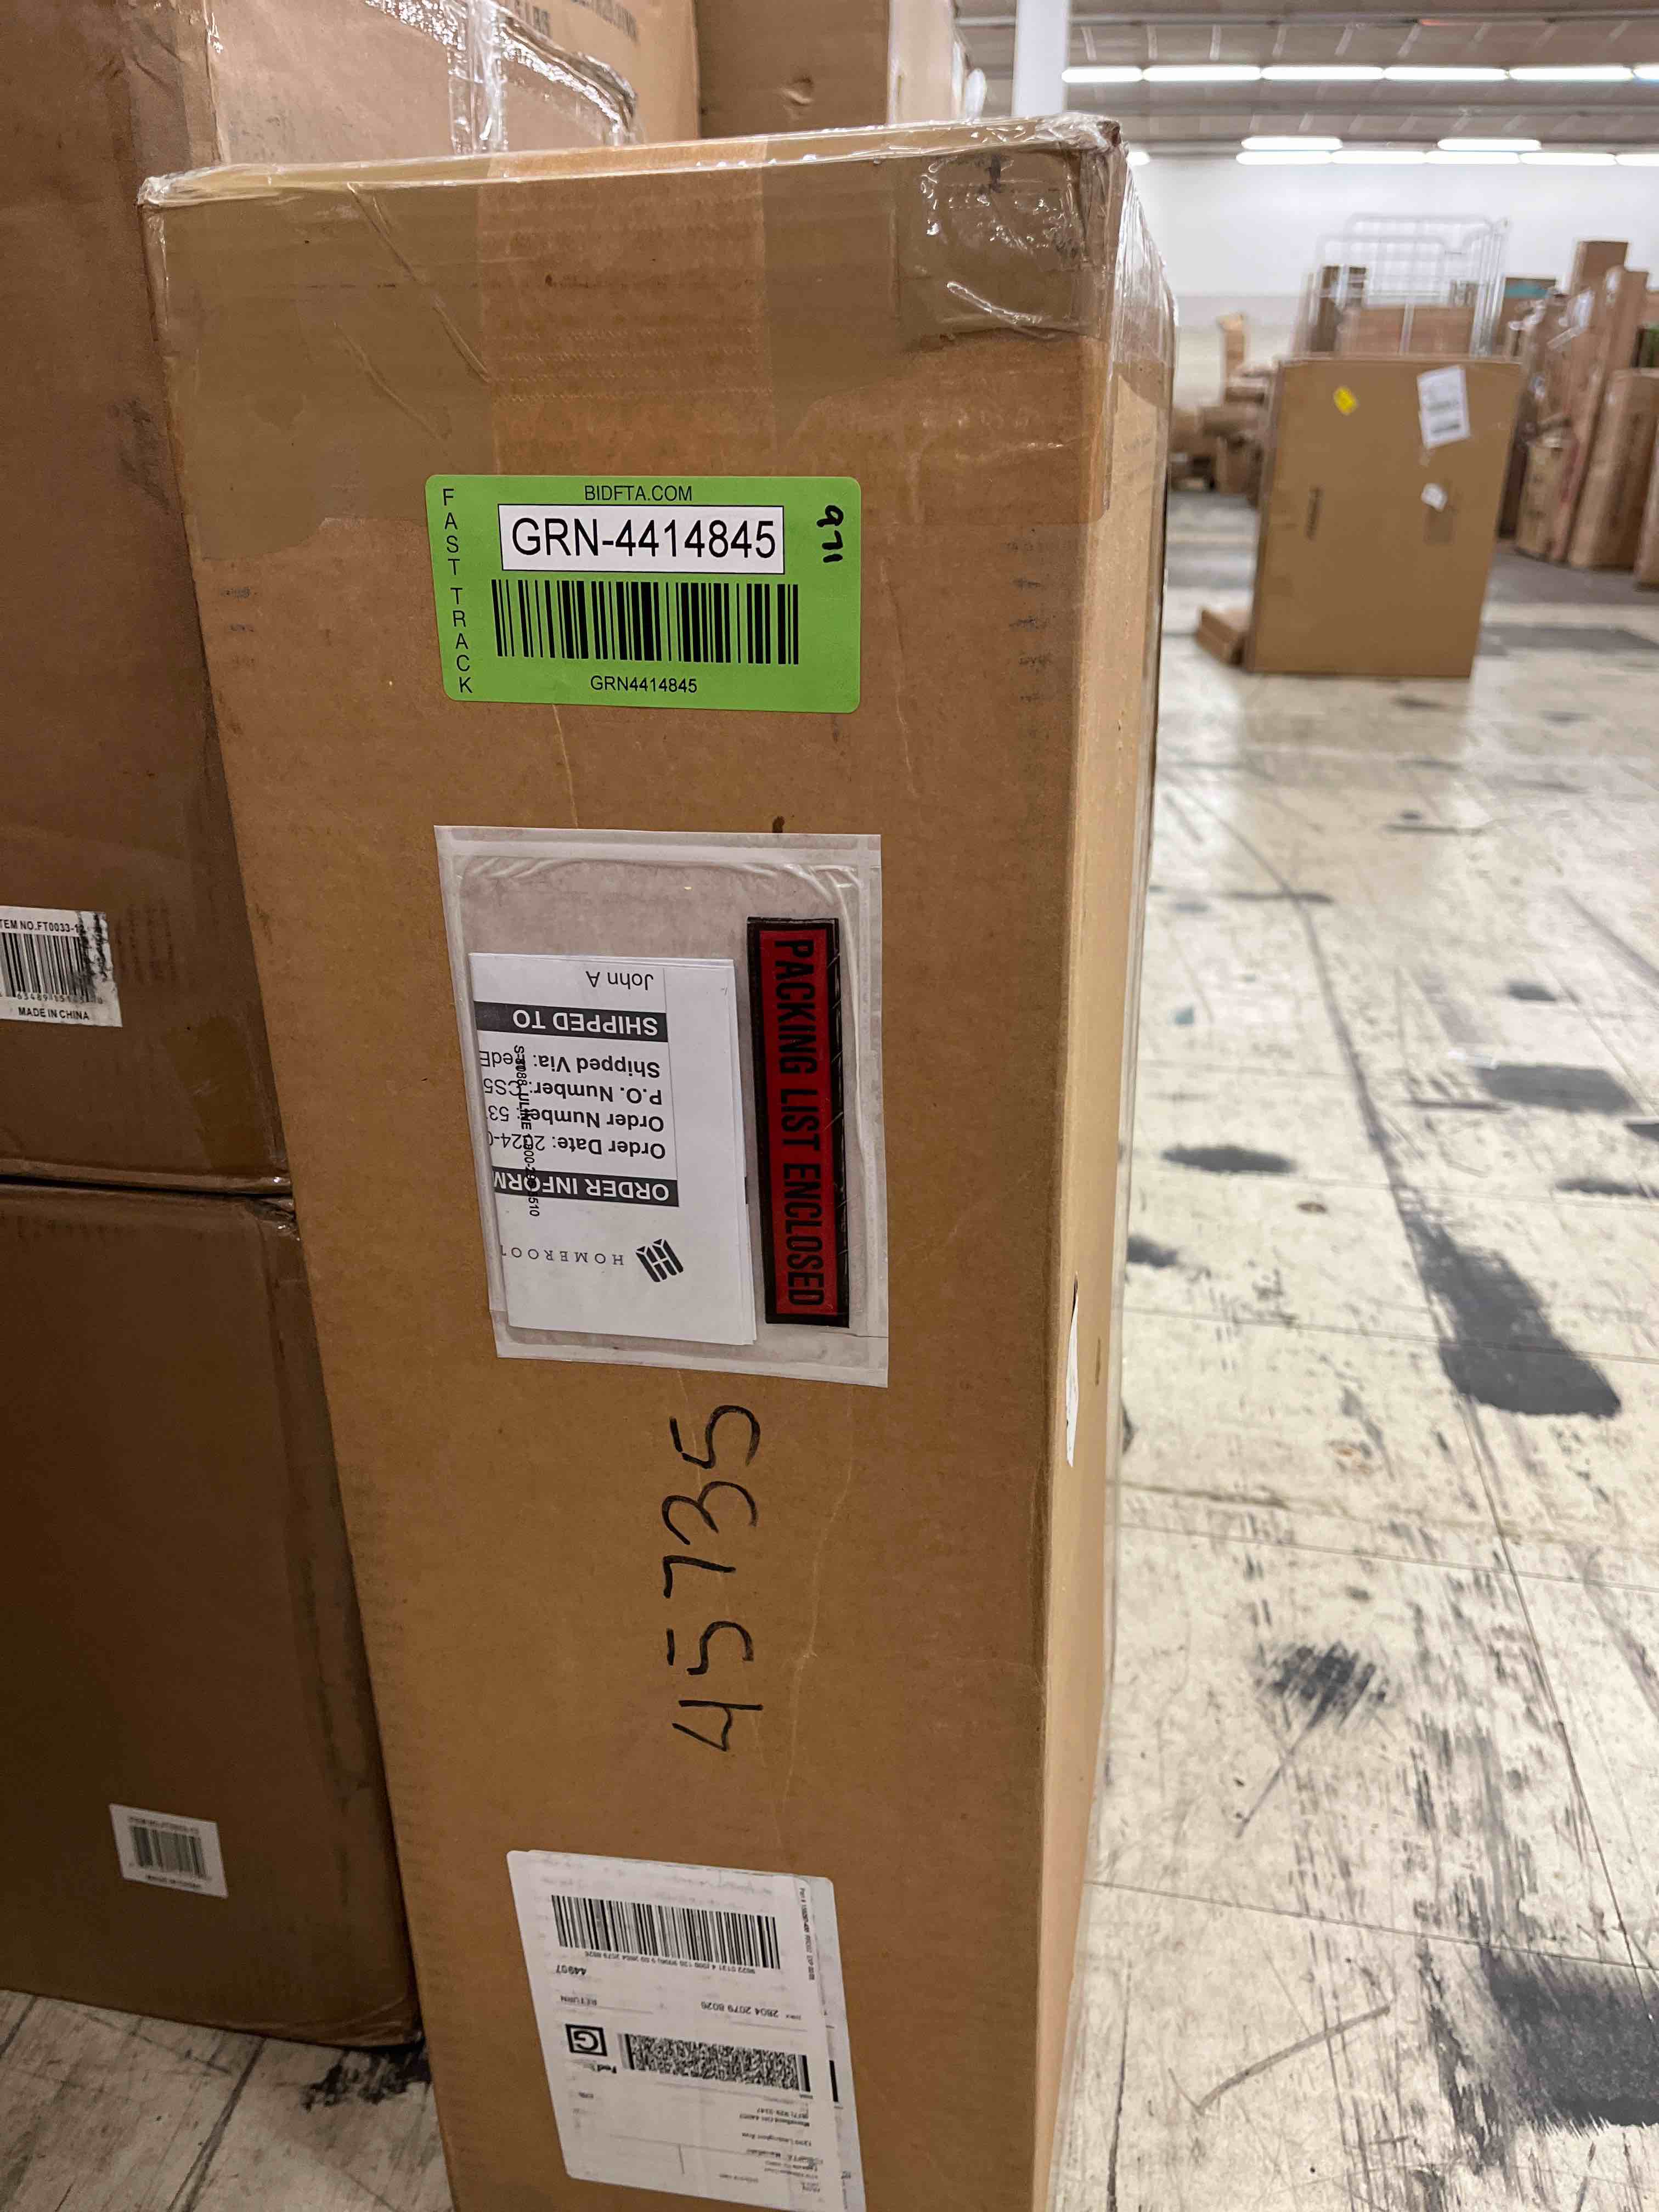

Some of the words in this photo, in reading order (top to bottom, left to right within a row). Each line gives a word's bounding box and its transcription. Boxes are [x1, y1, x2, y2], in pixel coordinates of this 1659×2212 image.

[584, 484, 692, 501] BIDFTA.COM
[511, 517, 776, 558] GRN-4414845
[590, 675, 697, 693] GRN4414845
[585, 971, 601, 988] A
[607, 971, 654, 991] John
[18, 1007, 46, 1017] MADE
[48, 1008, 58, 1018] IN
[59, 1010, 89, 1020] CHINA
[774, 938, 817, 1075] PACKING
[512, 1009, 546, 1030] TO
[552, 1011, 658, 1036] SHIPPED
[533, 1054, 571, 1074] Via:
[576, 1055, 660, 1078] Shipped
[528, 1081, 613, 1103] Number:
[620, 1086, 662, 1105] P.O.
[485, 1104, 510, 1122] 53
[606, 1113, 664, 1132] Order
[781, 1087, 821, 1152] LIST
[551, 1135, 602, 1155] Date:
[607, 1140, 665, 1159] Order
[583, 1177, 670, 1201] ORDER
[783, 1165, 825, 1308] ENCLOSED
[574, 2030, 599, 2051] G
